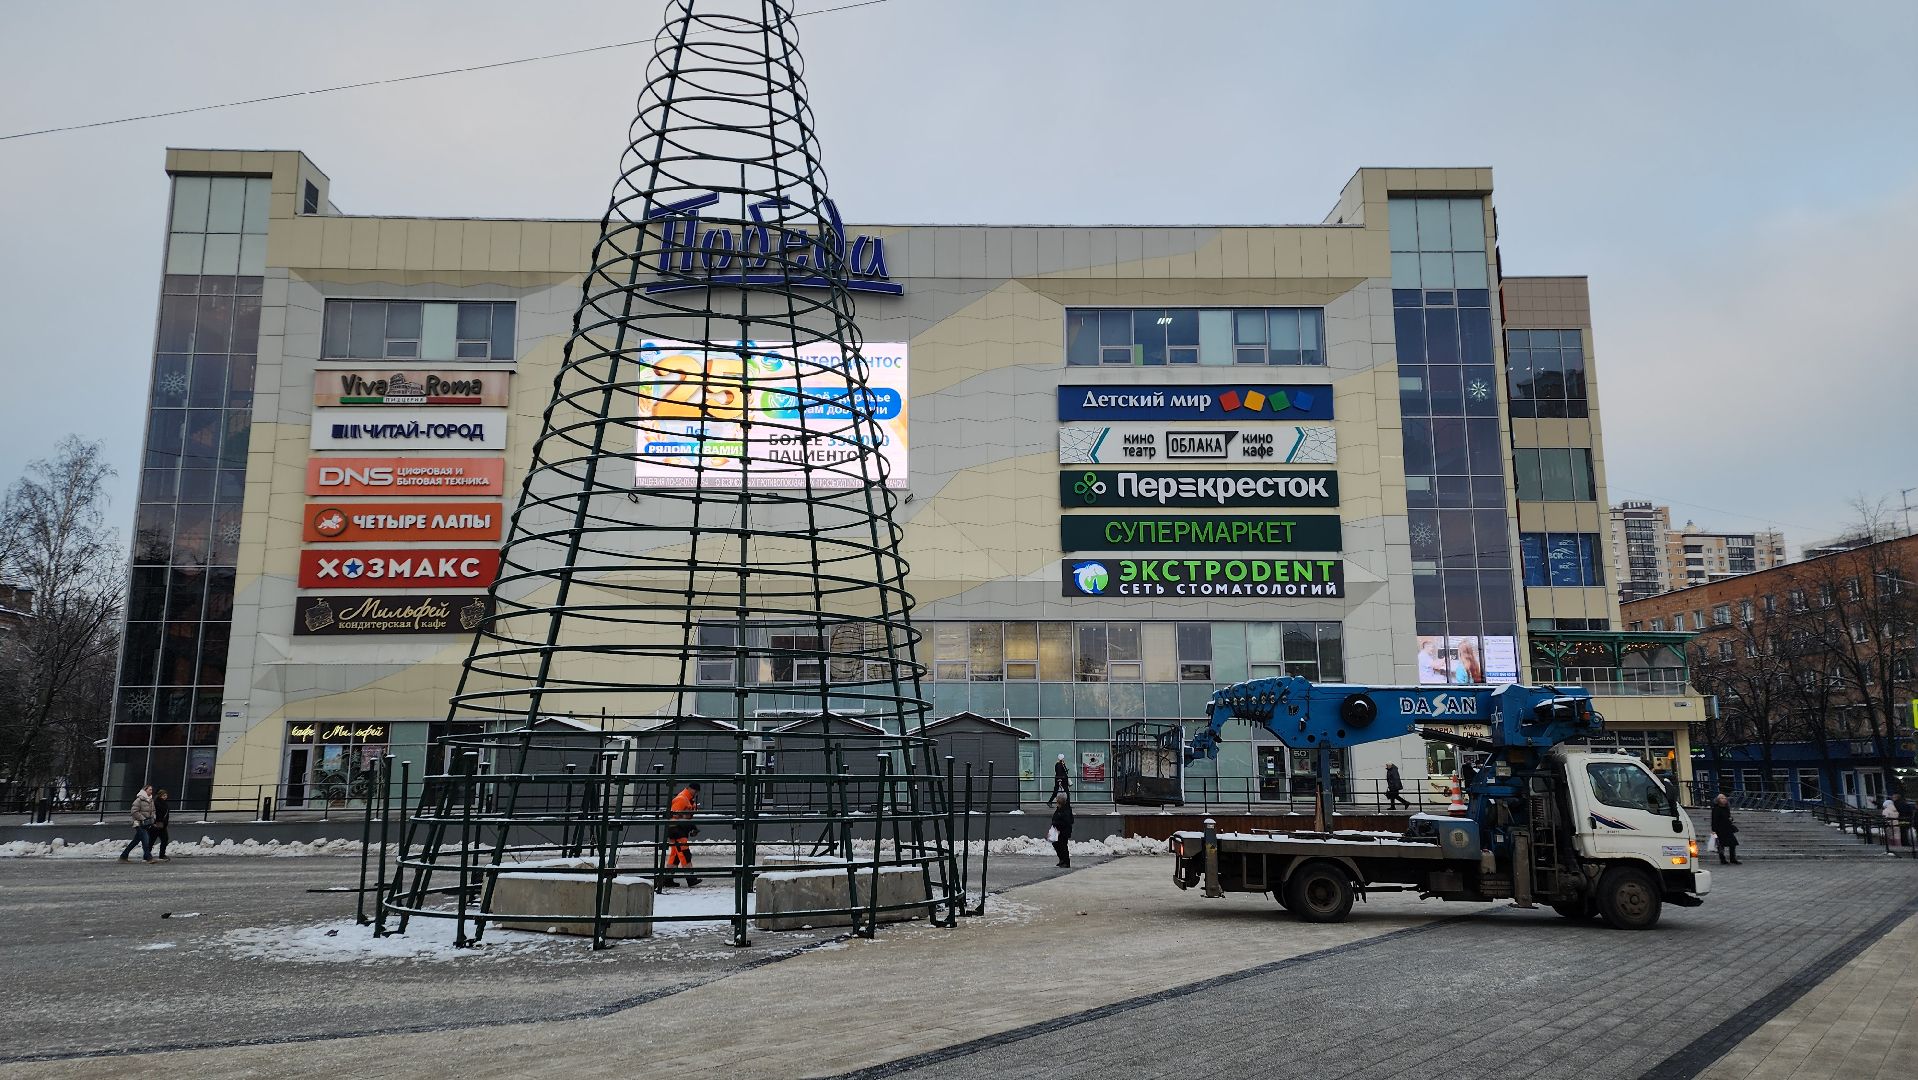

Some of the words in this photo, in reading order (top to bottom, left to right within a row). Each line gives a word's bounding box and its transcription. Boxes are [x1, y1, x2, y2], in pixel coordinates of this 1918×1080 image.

[648, 191, 890, 279] Победа
[341, 374, 387, 396] Viva
[426, 374, 483, 396] Roma
[1082, 390, 1165, 408] Детский
[1170, 393, 1212, 412] мир
[363, 420, 485, 442] ЧИТАЙ-ГОРОД
[1123, 433, 1155, 444] кино
[1242, 433, 1274, 444] кино
[1122, 445, 1157, 458] театр
[1171, 437, 1223, 453] ОБЛАКА
[1242, 445, 1274, 459] кафе
[769, 449, 869, 462] ПАЦИЕНТО
[318, 467, 394, 487] DNS
[396, 468, 452, 476] ЦИФРОВАЯ
[455, 468, 464, 476] И
[396, 478, 443, 486] БЫТОВАЯ
[445, 477, 490, 486] ТЕХНИКА
[353, 514, 427, 530] ЧЕТЫРЕ
[431, 514, 491, 530] ЛАПЫ
[1105, 521, 1297, 544] СУПЕРМАРКЕТ
[1119, 583, 1165, 595] СЕТЬ
[1176, 582, 1337, 595] СТОМАТОЛОГИЙ
[338, 597, 450, 629] Мильфей
[338, 619, 412, 629] кондитерская
[420, 619, 447, 630] кафе
[1400, 693, 1478, 717] DASAN
